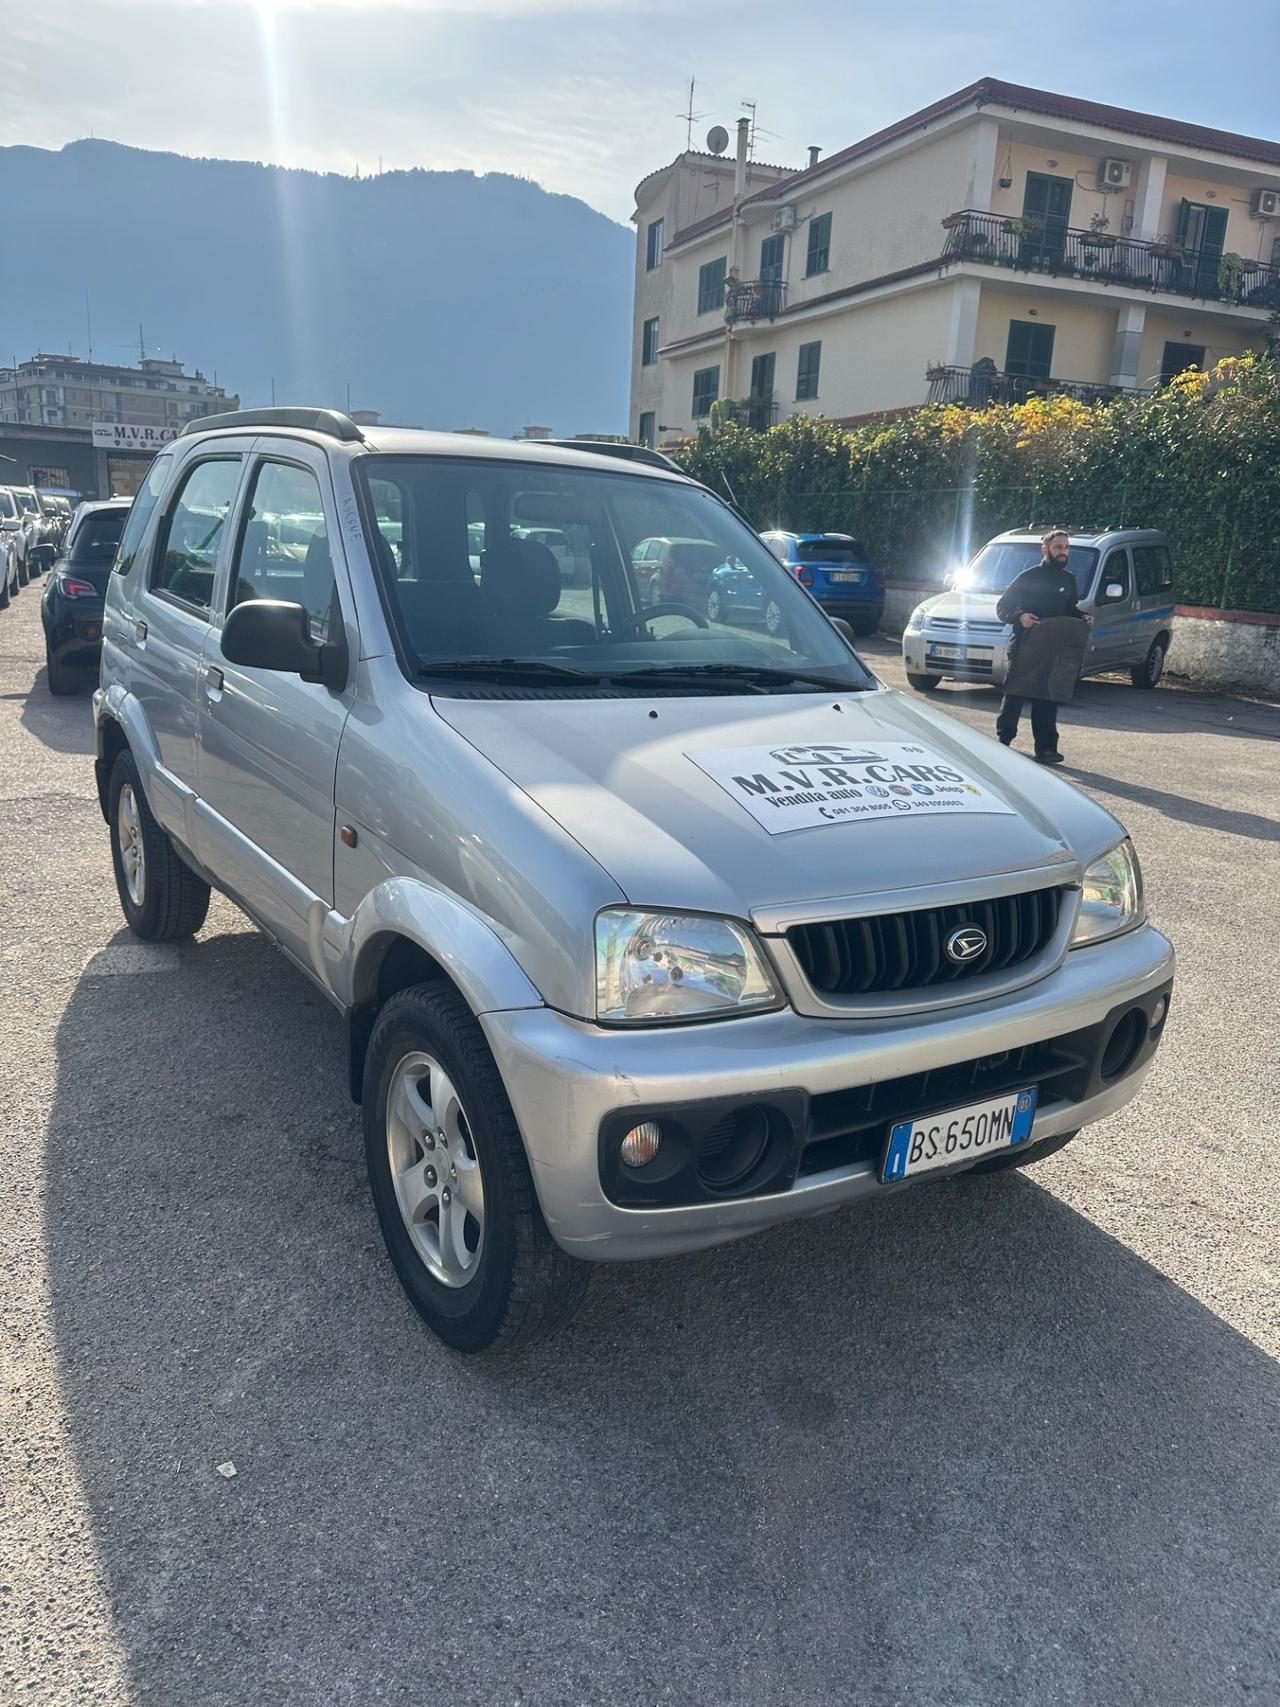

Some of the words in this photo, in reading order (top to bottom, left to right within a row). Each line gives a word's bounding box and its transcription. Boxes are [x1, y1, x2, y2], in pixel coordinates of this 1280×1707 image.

[114, 426, 181, 441] M.V.R.CA
[731, 764, 964, 796] M.V.R.CARS
[765, 791, 828, 809] Vendita
[827, 786, 863, 802] auto
